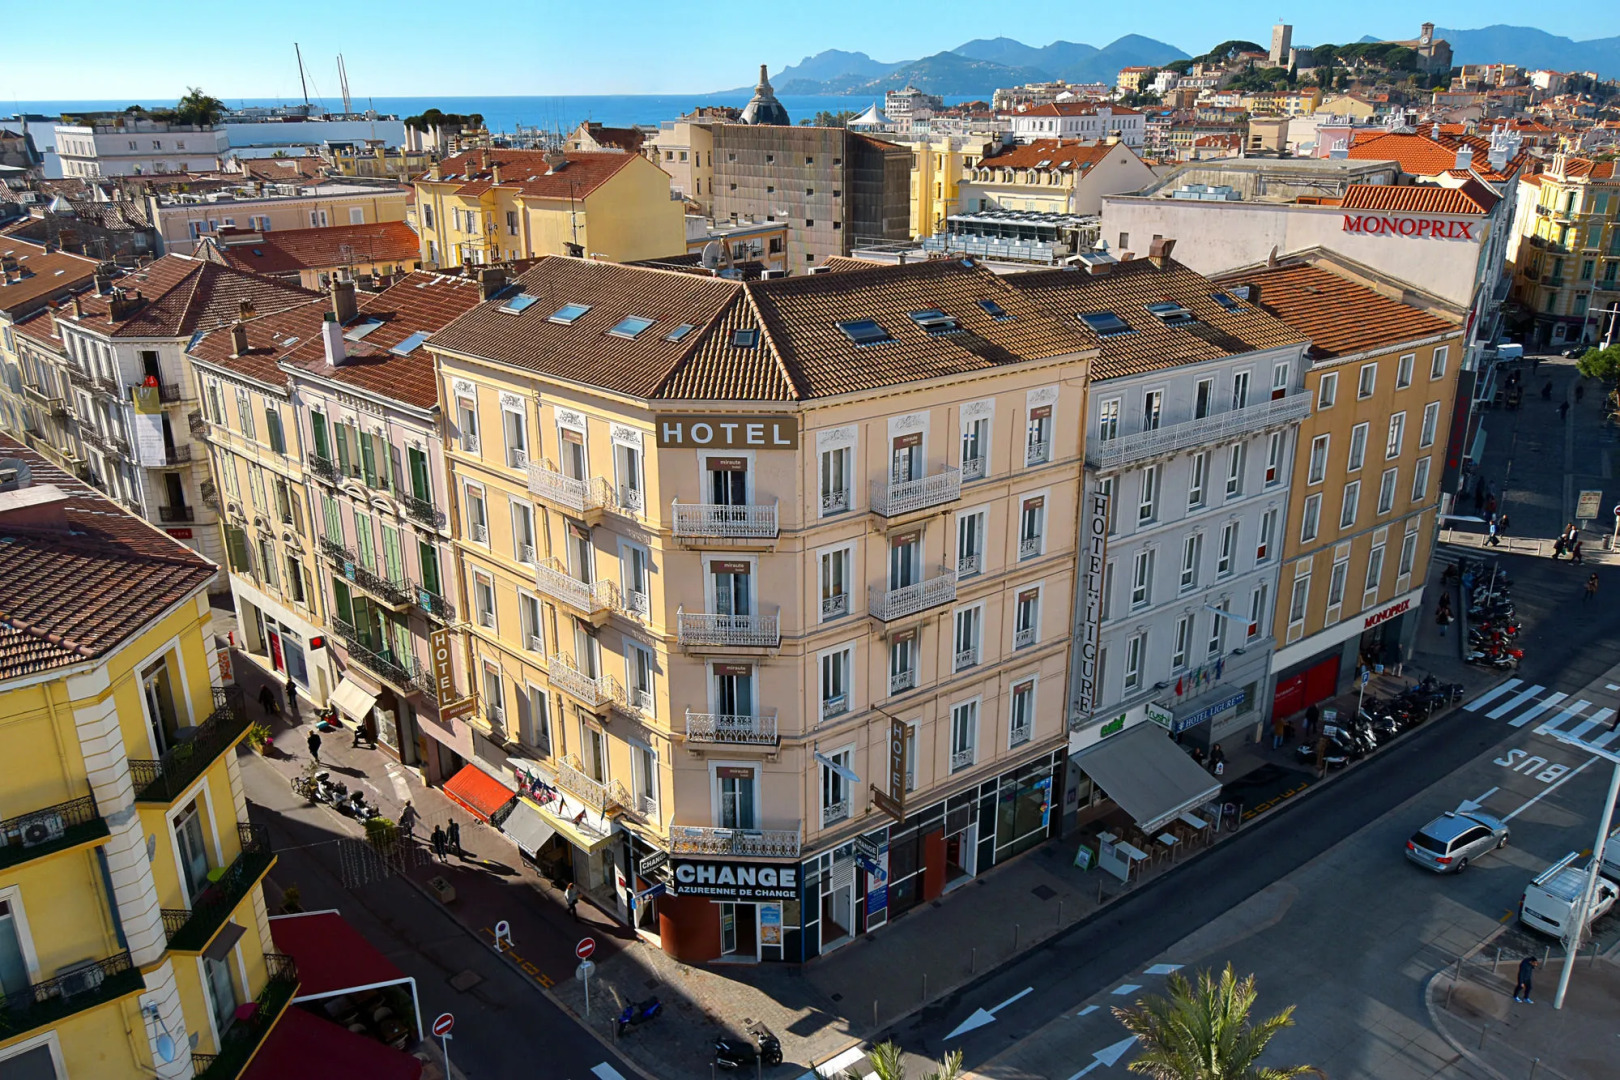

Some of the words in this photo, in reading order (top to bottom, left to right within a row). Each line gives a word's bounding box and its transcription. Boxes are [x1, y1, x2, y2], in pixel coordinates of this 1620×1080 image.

[1342, 214, 1473, 239] MONOPRIX
[662, 422, 791, 445] HOTEL
[1087, 496, 1107, 593] HOTEL
[1364, 599, 1411, 629] MONOPRIX
[434, 633, 452, 704] HOTEL
[1079, 606, 1098, 715] LIGURE
[1185, 712, 1208, 728] HOTEL
[1210, 699, 1235, 716] LIGURE
[892, 723, 903, 803] HOTEL
[1494, 749, 1570, 783] BUS
[1242, 783, 1308, 820] HOTEL
[675, 864, 797, 888] CHANGE
[677, 886, 737, 896] AZUREENNE
[739, 888, 753, 896] DE
[754, 889, 797, 898] CHANGE
